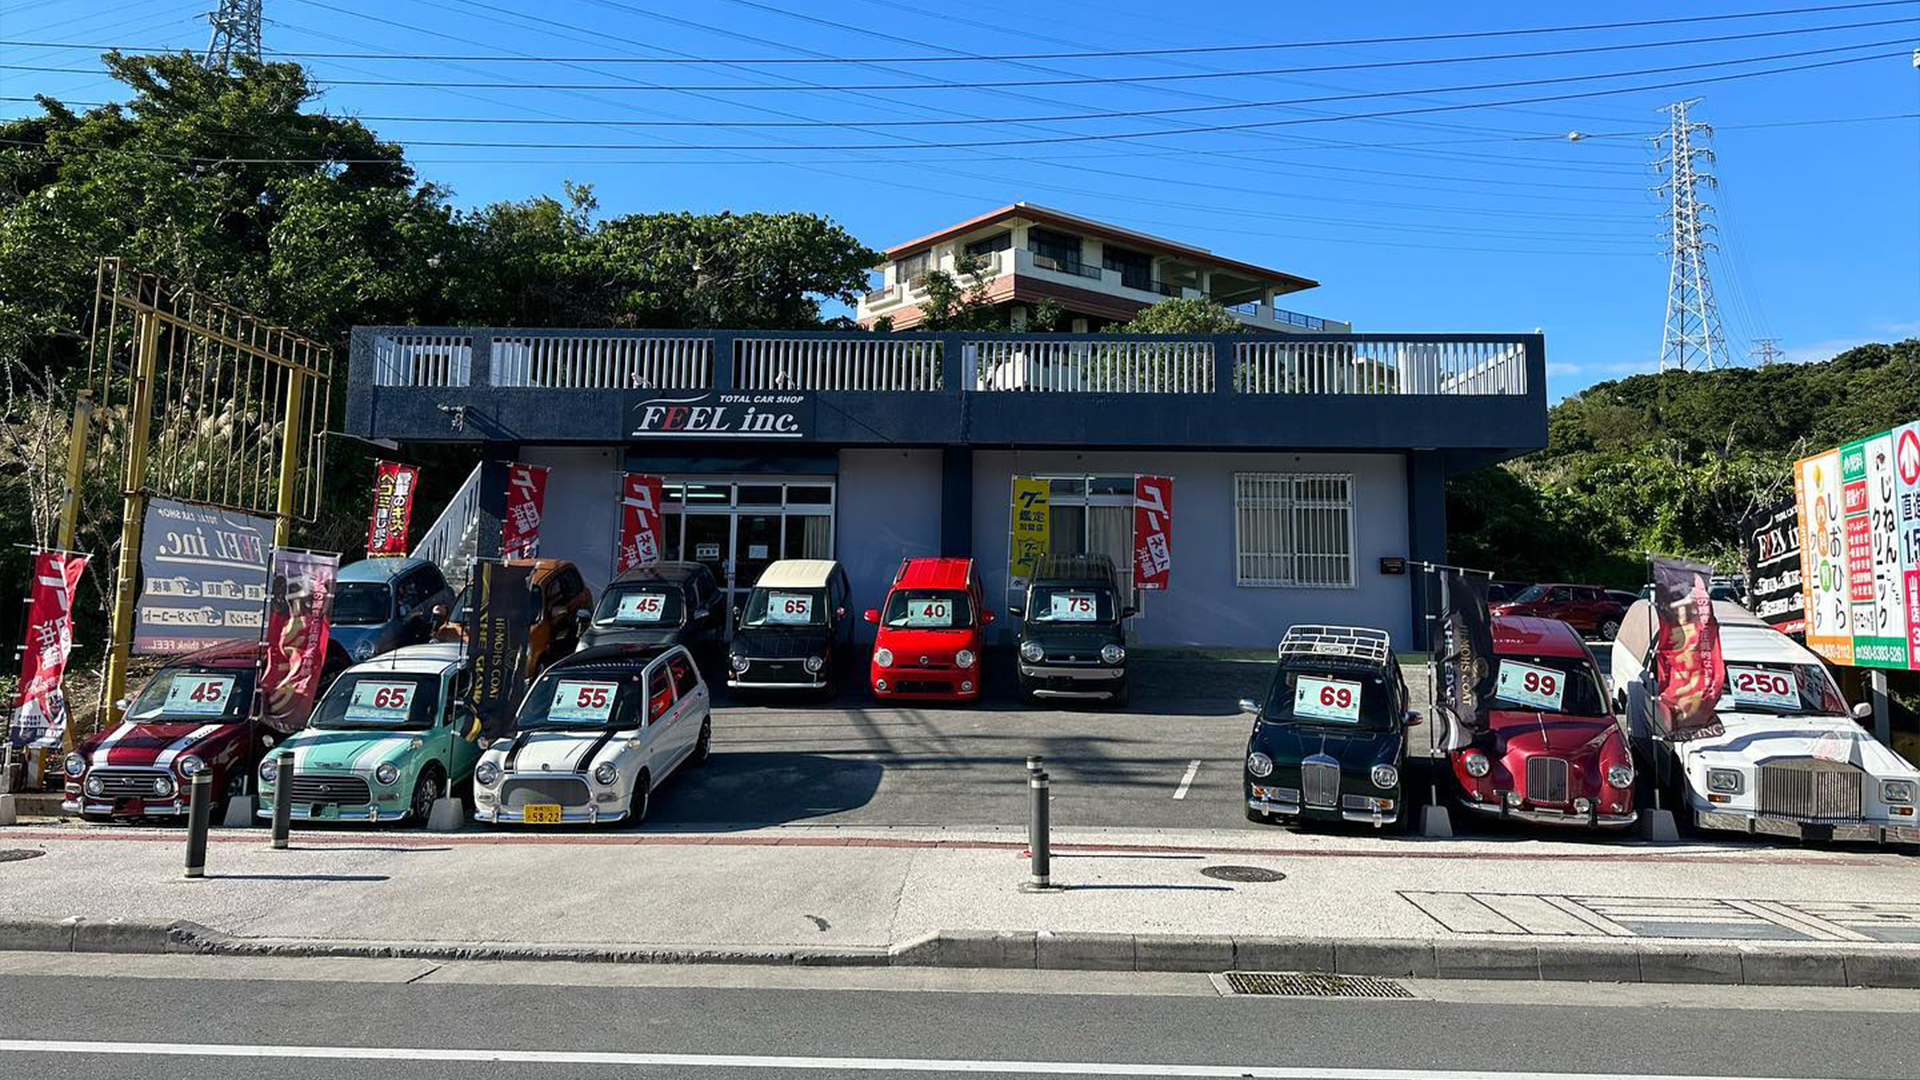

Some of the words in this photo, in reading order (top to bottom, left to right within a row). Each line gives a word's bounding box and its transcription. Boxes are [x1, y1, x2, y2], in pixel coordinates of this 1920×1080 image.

[719, 395, 751, 404] TOTAL
[753, 395, 774, 404] CAR
[776, 395, 805, 404] SHOP
[637, 405, 731, 432] FEEL
[738, 406, 799, 432] inc.
[1019, 490, 1046, 509] グー
[1881, 475, 1897, 564] じねん
[1828, 492, 1847, 630] しおひら
[1873, 507, 1888, 629] クリニック
[1810, 531, 1822, 630] クリニック
[636, 598, 659, 612] 45
[784, 600, 806, 614] 65
[923, 604, 946, 618] 40
[1068, 597, 1090, 612] 75
[190, 681, 223, 703] 45
[1523, 671, 1556, 696] 99
[1738, 673, 1790, 696] 250
[374, 687, 408, 709] 65
[576, 687, 609, 709] 55
[1319, 686, 1352, 709] 69
[533, 812, 560, 822] 58-22
